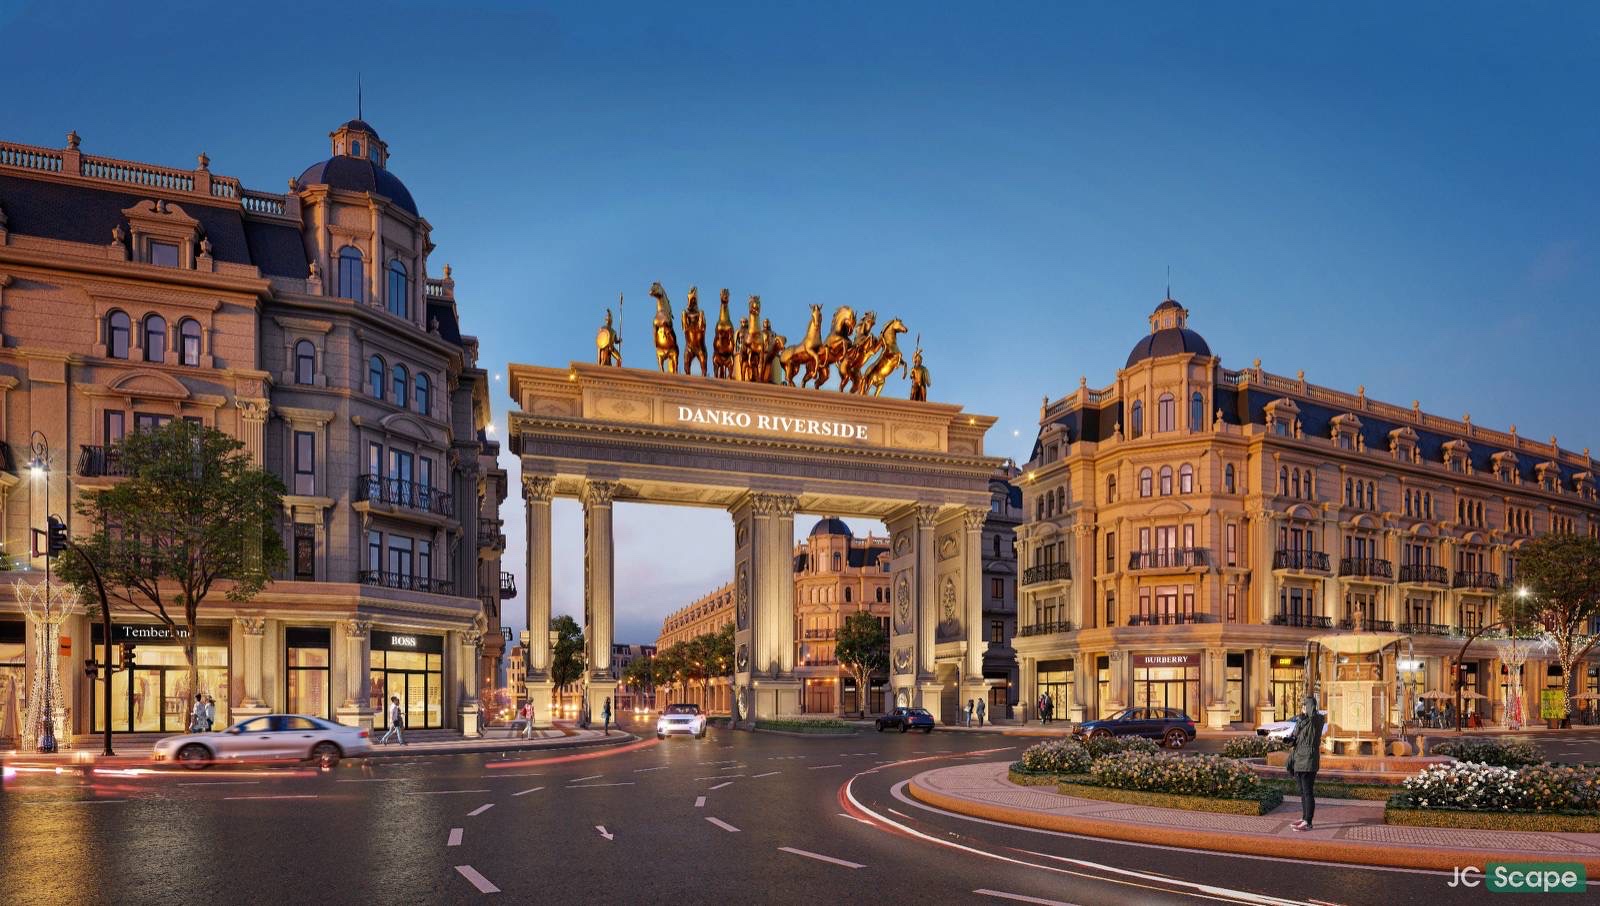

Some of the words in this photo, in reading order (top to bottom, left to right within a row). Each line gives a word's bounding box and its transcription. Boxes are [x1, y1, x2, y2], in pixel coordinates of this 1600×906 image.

[678, 406, 750, 428] DANKO
[757, 415, 868, 440] RIVERSIDE
[122, 626, 191, 638] Temberln
[391, 636, 416, 646] BOSS
[1145, 655, 1188, 663] BURBERRY
